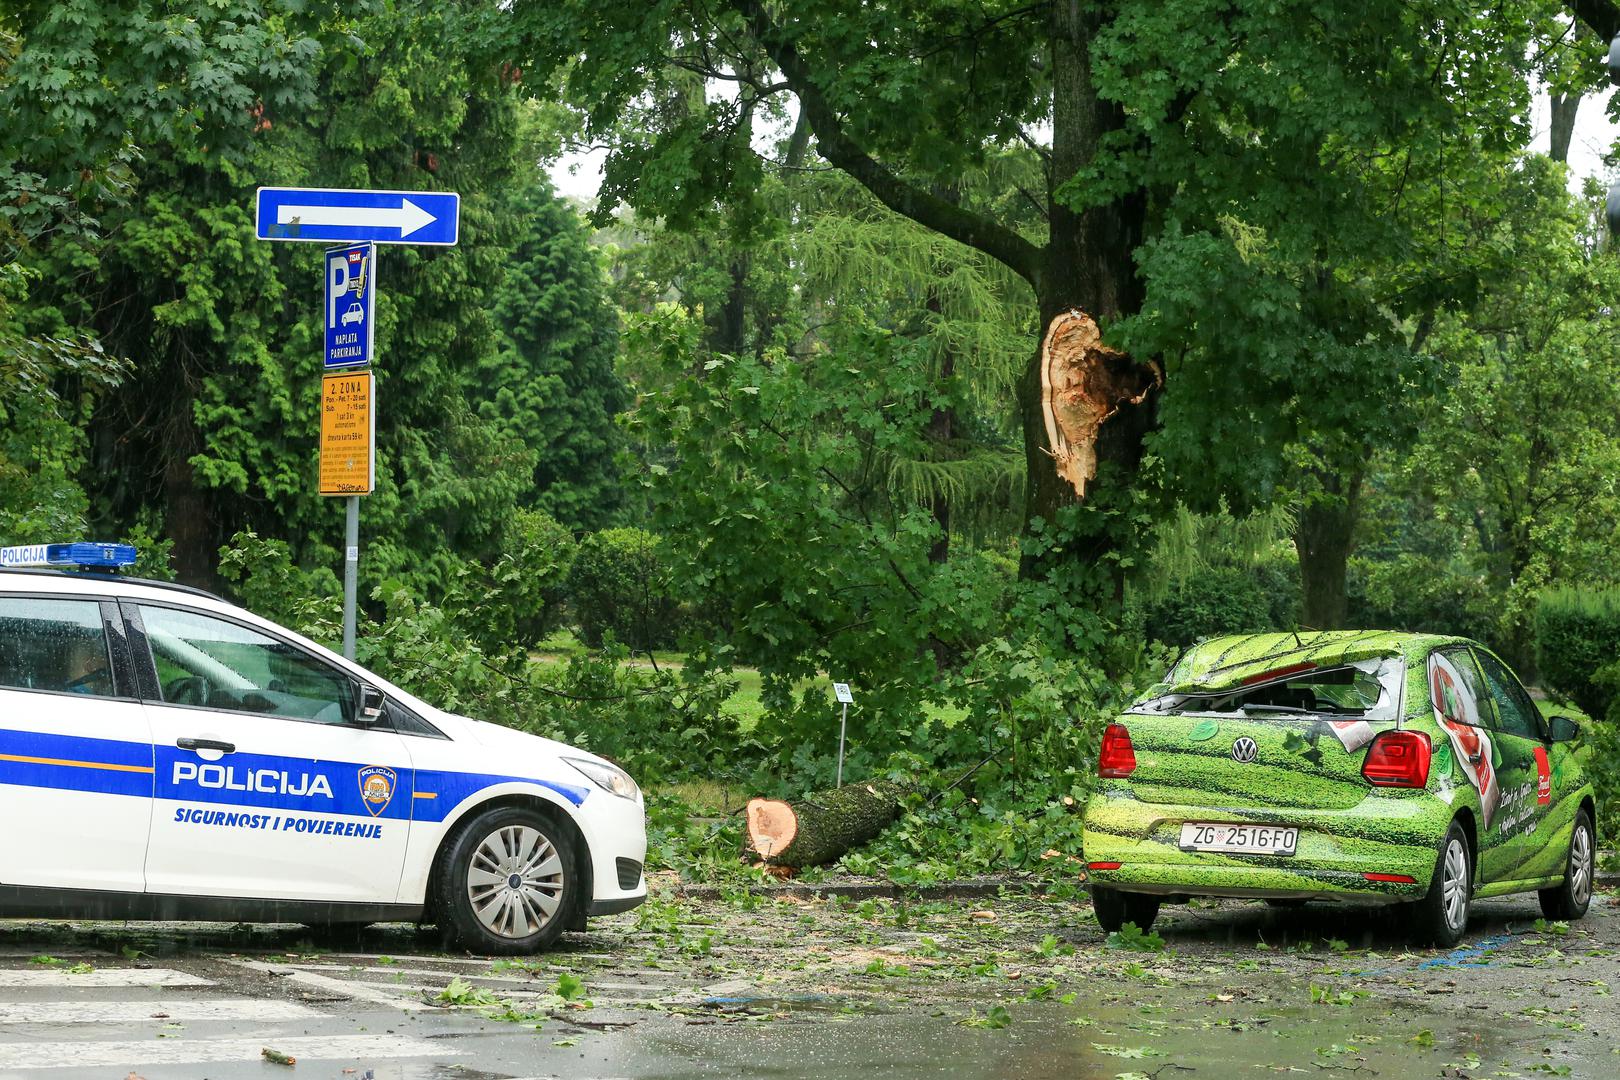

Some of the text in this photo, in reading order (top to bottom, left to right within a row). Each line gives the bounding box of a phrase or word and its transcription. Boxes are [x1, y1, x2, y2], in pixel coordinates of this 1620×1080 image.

[330, 257, 349, 328] P
[335, 333, 357, 345] NAPLATA
[331, 346, 361, 359] PARKIRANJA
[340, 382, 360, 393] ZONA
[2, 547, 45, 563] POLICIJA
[172, 761, 334, 799] POLICIJA
[361, 768, 394, 779] POLICIJA
[174, 807, 383, 840] SIGURNOST I POVJERENJE
[1193, 826, 1216, 844] ZG
